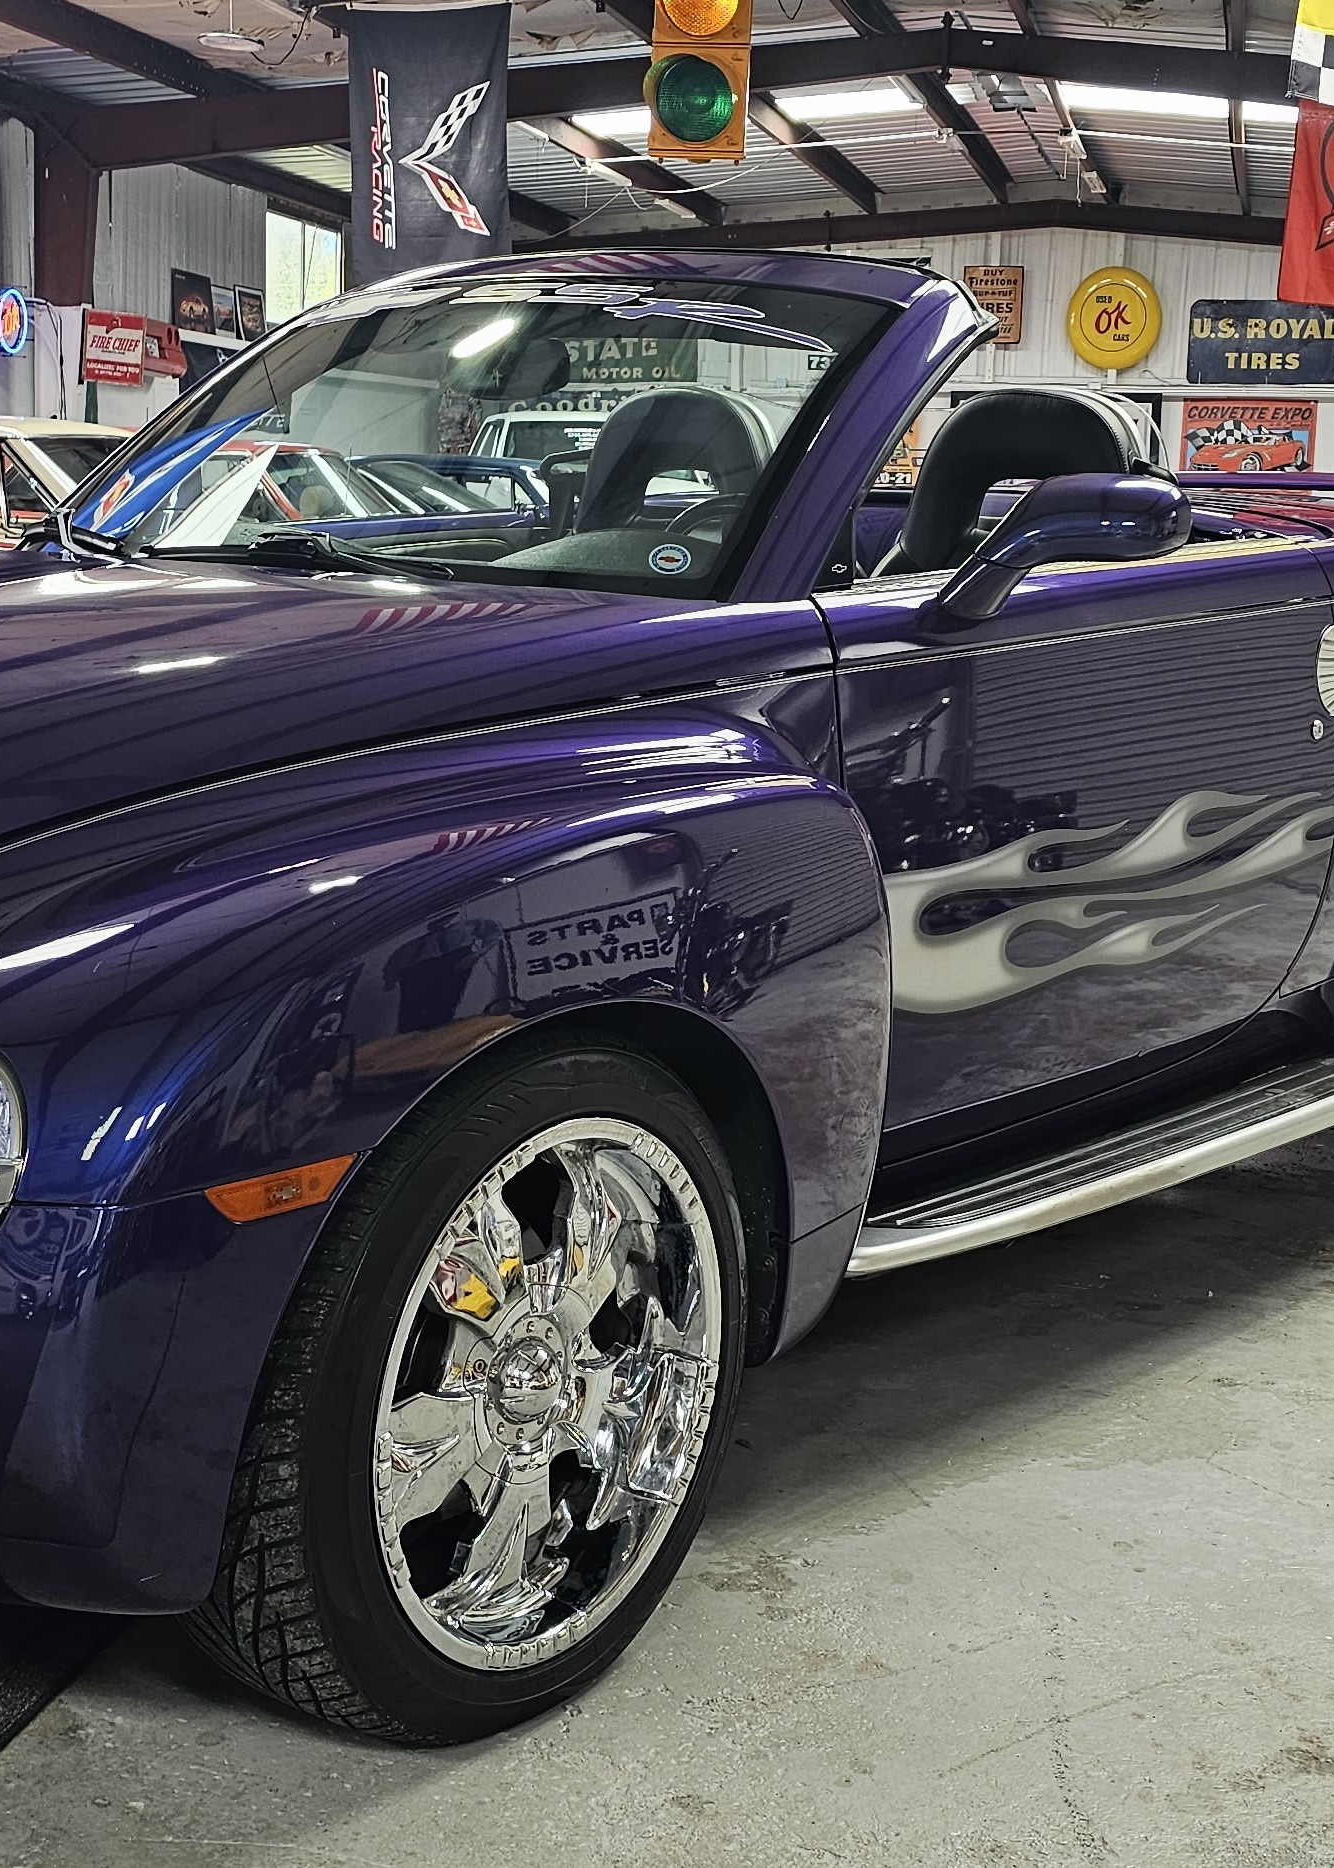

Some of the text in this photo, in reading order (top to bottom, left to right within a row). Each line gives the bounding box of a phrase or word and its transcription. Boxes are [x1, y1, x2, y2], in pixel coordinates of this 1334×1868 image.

[371, 68, 384, 243] RACING
[377, 71, 396, 250] CORVETTE
[968, 277, 1018, 287] Firestone
[1095, 300, 1132, 334] OK
[1192, 317, 1240, 339] U.S.
[90, 335, 140, 352] FIRE CHIEF
[566, 337, 658, 362] STATE
[809, 356, 837, 369] 73
[1225, 353, 1300, 370] TIRES
[582, 366, 643, 379] MOTOR
[508, 394, 627, 412] Goodr
[1187, 405, 1313, 420] CORVETTE EXPO
